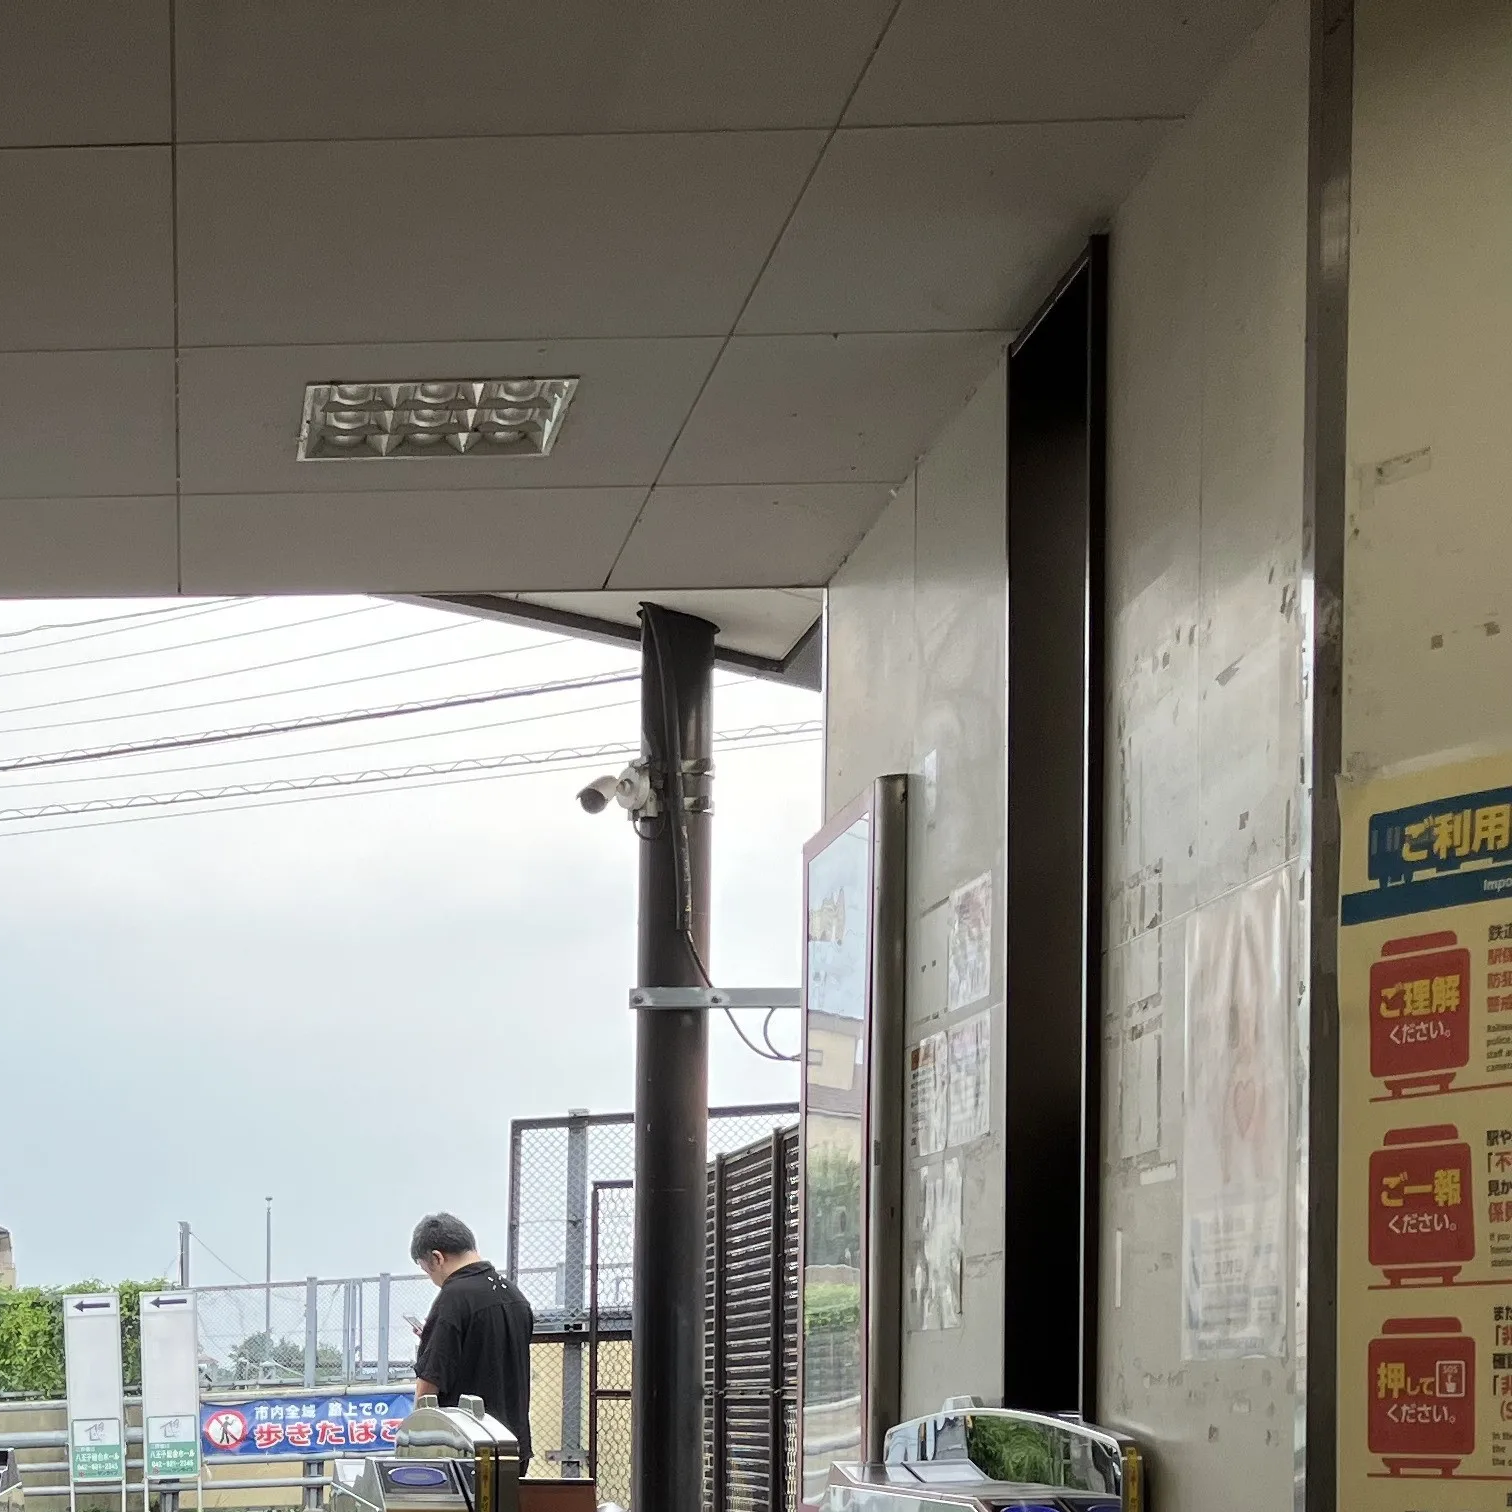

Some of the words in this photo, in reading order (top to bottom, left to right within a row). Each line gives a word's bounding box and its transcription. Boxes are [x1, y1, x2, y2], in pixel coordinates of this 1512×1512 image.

[1402, 803, 1511, 862] ご利用
[1380, 973, 1460, 1019] ご理解
[1389, 1020, 1451, 1045] ください。
[1381, 1168, 1462, 1207] ご一報
[1388, 1213, 1457, 1234] ください。
[1377, 1361, 1436, 1400] 押して
[254, 1403, 316, 1420] 市内全域
[328, 1401, 388, 1417] 路上での
[1387, 1403, 1456, 1424] ください。
[254, 1418, 406, 1448] 歩きたばこ
